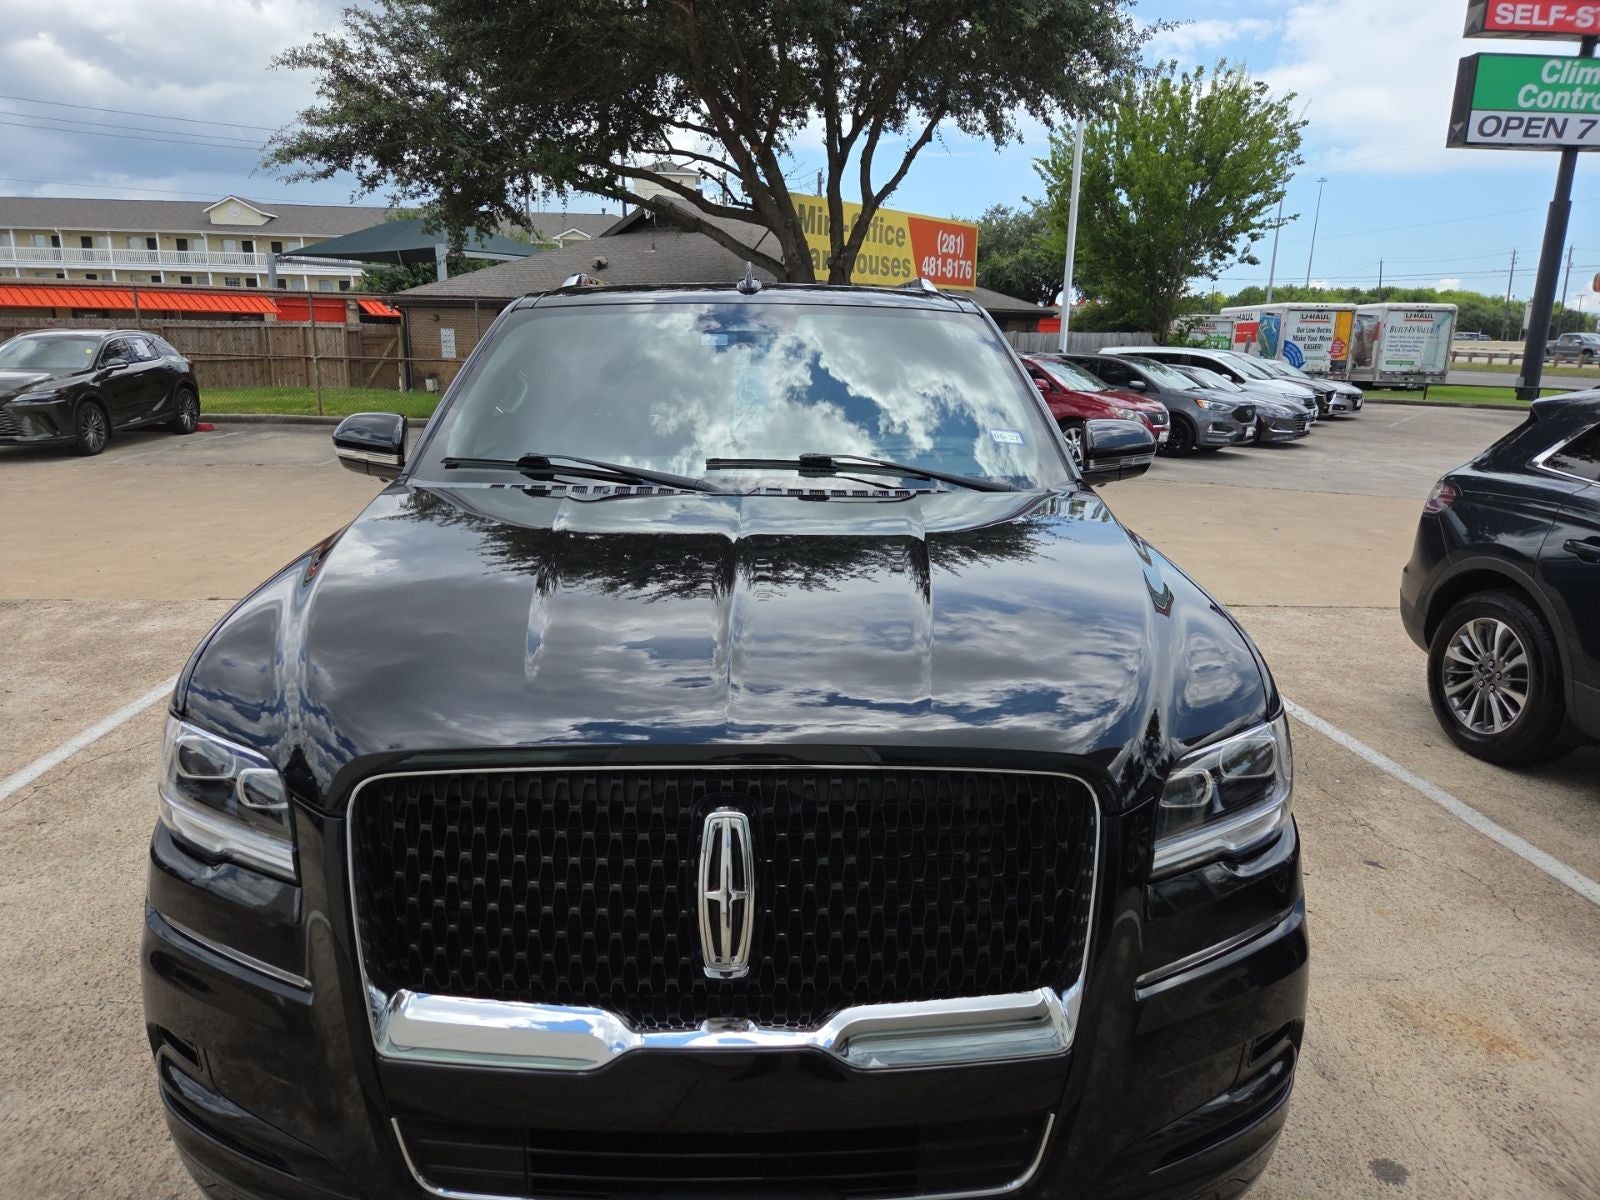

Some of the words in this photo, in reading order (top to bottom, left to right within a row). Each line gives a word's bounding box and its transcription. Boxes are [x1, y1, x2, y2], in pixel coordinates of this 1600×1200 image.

[1477, 115, 1569, 139] OPEN
[1577, 118, 1599, 140] 7
[937, 229, 964, 258] (281)
[922, 256, 972, 279] 481-8176
